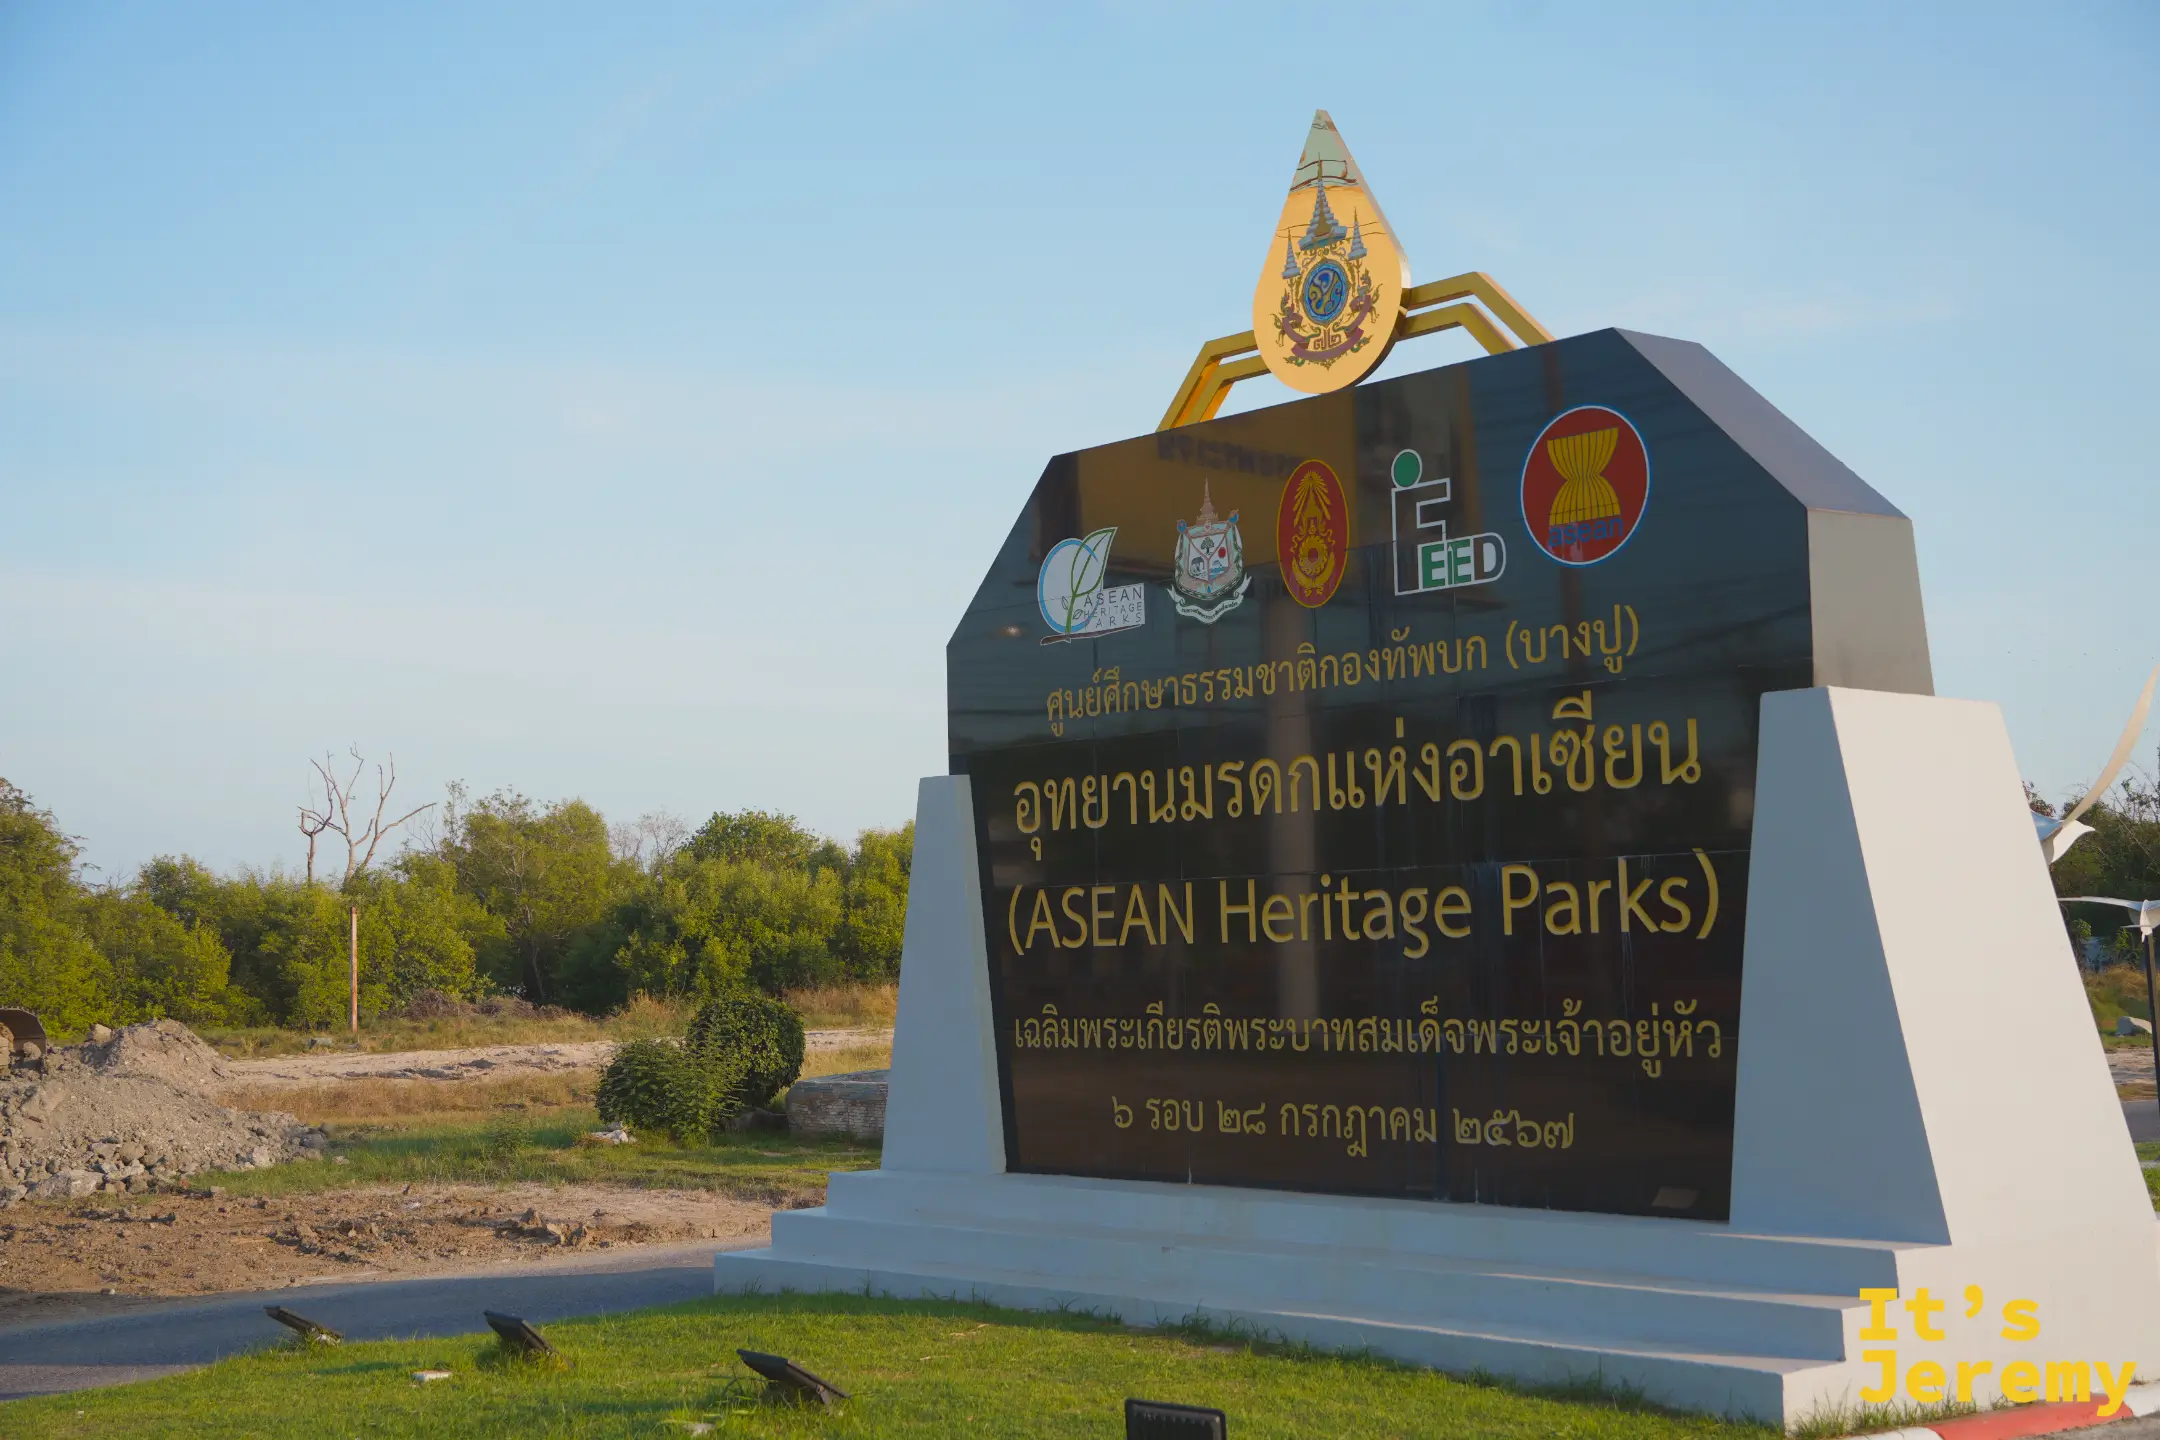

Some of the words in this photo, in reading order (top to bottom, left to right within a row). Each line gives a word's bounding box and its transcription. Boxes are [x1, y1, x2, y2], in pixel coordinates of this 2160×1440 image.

[1548, 516, 1624, 548] asean
[1083, 602, 1143, 619] HERITAGE
[1084, 586, 1142, 607] ASEAN
[1046, 626, 1488, 737] ศูนย์ศึกษาธรรมชาติกองทัพบก
[1505, 603, 1640, 675] (บางปู)
[1013, 690, 1702, 861] อุทยานมรดกแห่งอาเซียน
[1008, 881, 1195, 956] (ASEAN
[1219, 873, 1472, 959] Heritage
[1501, 847, 1719, 940] Parks)
[1014, 995, 1722, 1078] เฉลิมพระเกียรติพระบาทสมเด็จพระเจ้าอยู่หัว
[1111, 1095, 1134, 1129] ๖
[1146, 1098, 1204, 1133] รอบ
[1217, 1100, 1266, 1135] ๒๘
[1280, 1103, 1438, 1158] กรกฎาคม
[1453, 1107, 1575, 1150] ๒๕๖๗
